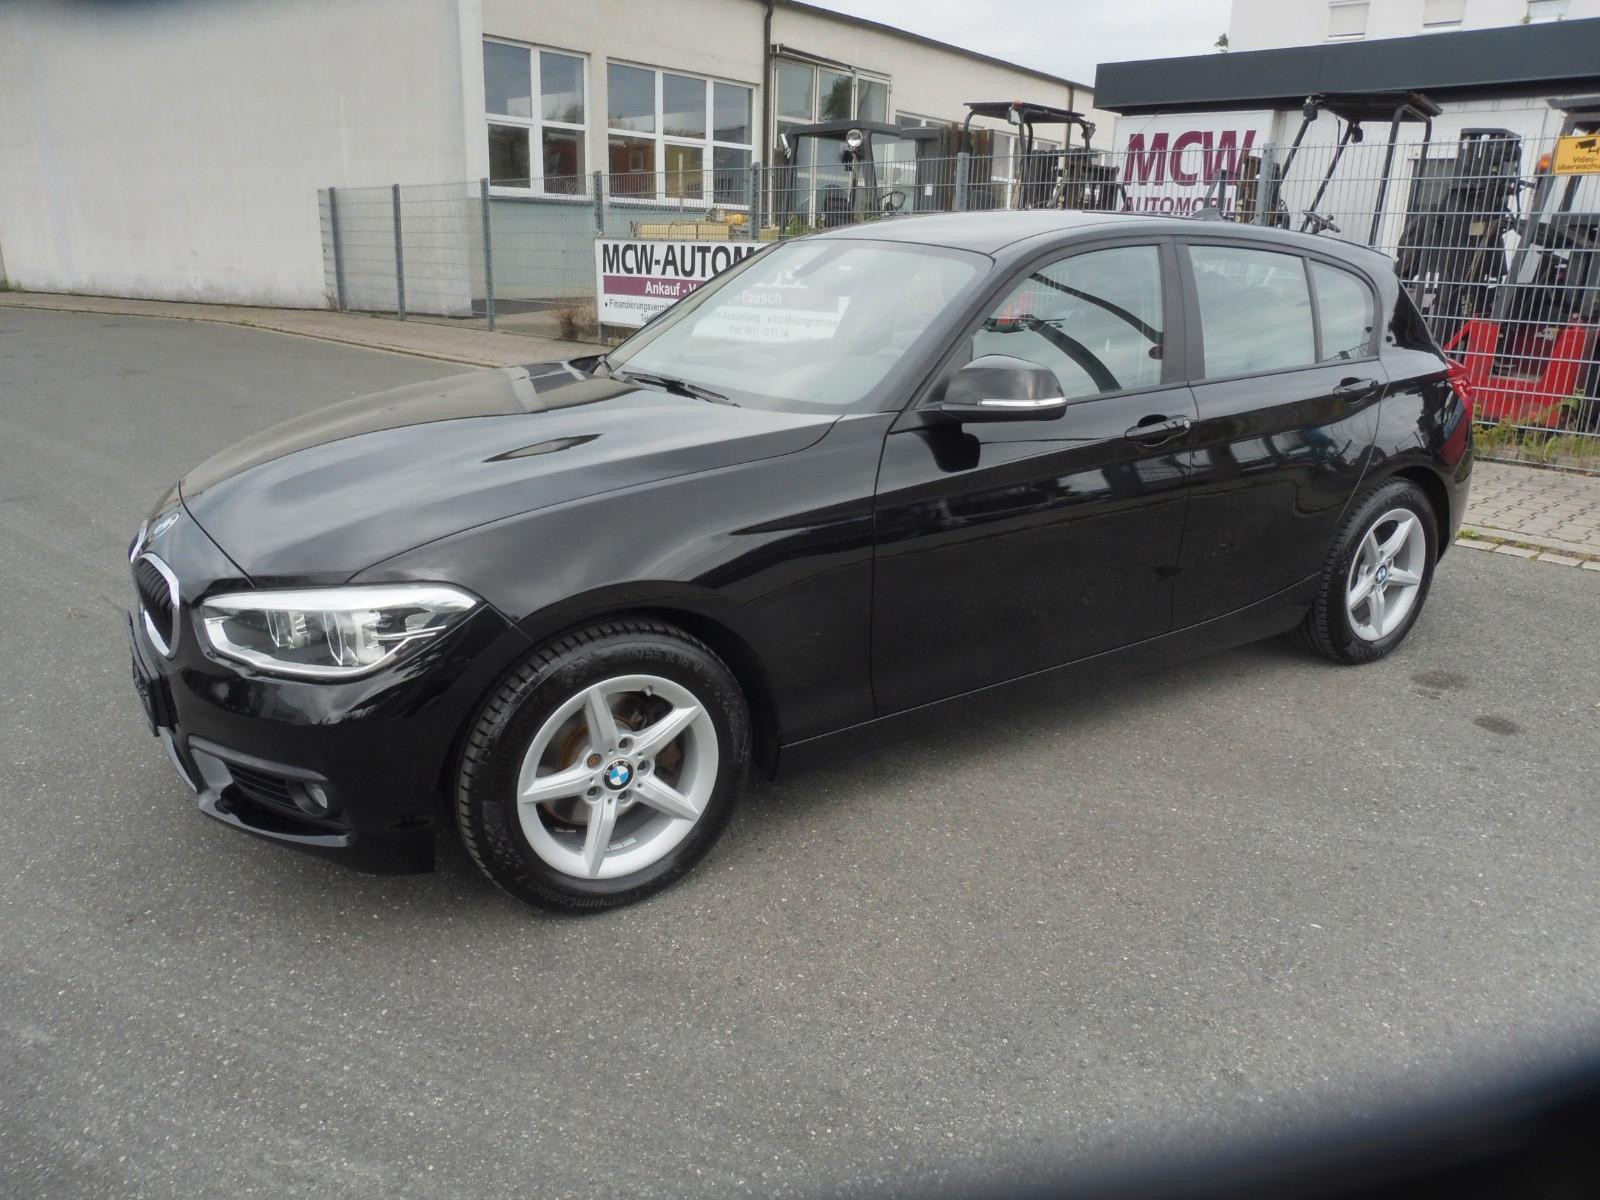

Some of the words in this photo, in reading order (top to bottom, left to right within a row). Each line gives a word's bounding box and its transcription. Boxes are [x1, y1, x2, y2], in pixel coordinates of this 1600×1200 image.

[1123, 130, 1257, 187] MCW
[1121, 196, 1236, 217] AUTOMOL
[645, 280, 681, 297] Ankauf
